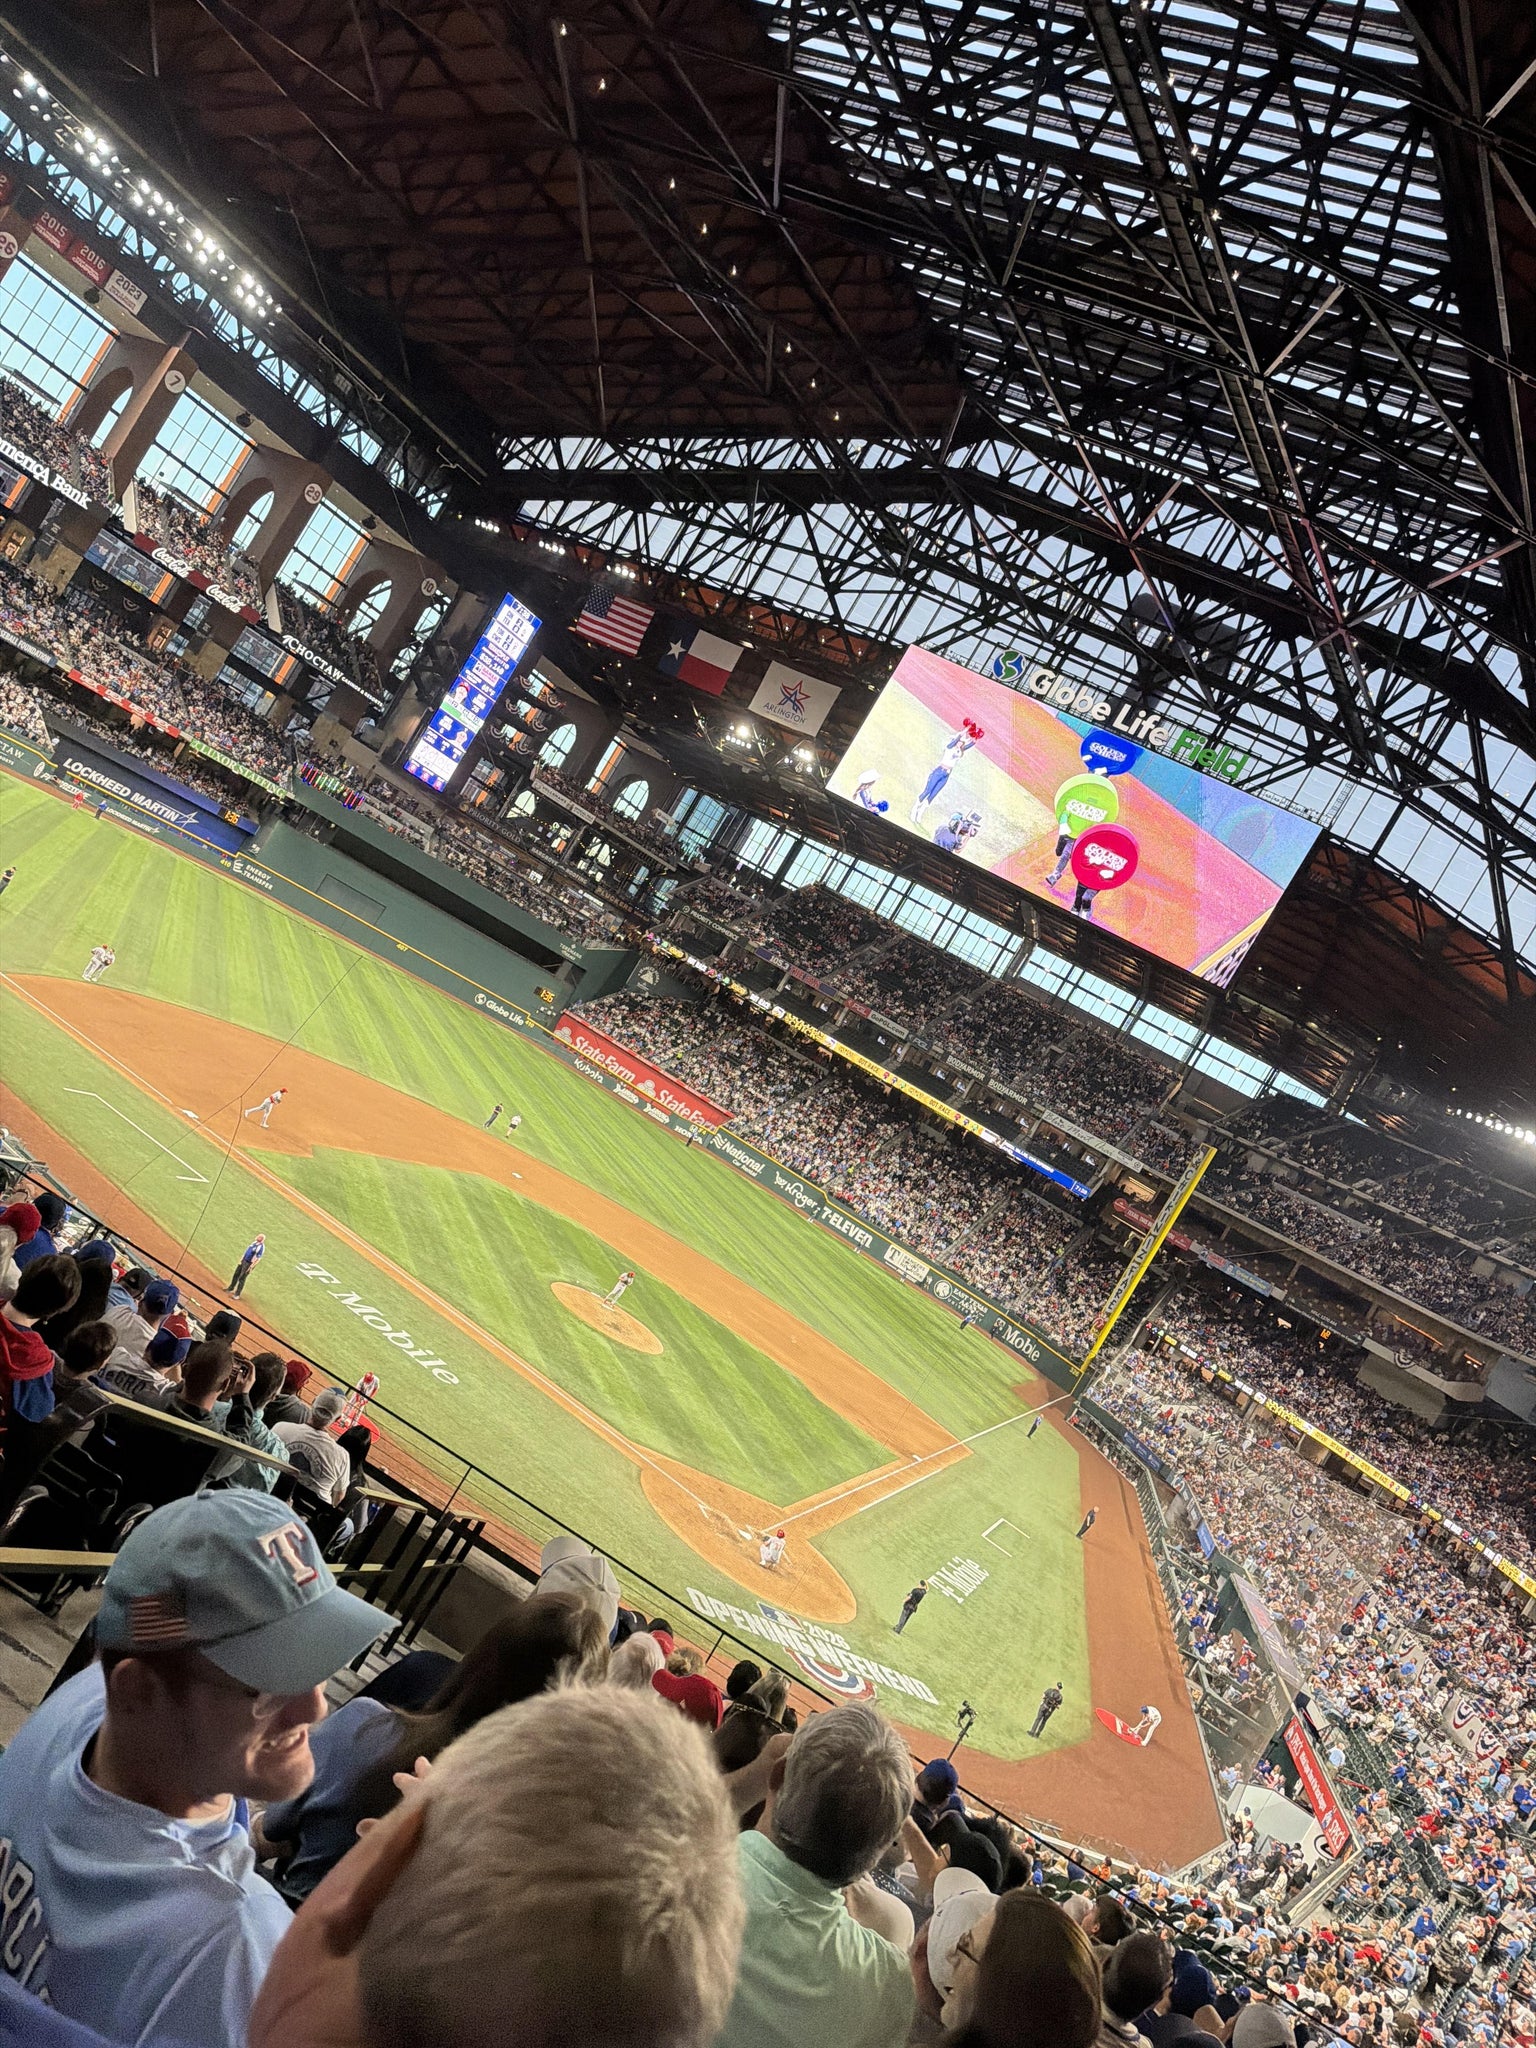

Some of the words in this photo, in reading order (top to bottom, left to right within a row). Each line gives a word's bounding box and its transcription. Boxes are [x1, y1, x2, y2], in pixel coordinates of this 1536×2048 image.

[40, 211, 69, 237] 2015
[79, 245, 107, 270] 2016
[115, 274, 143, 301] 2023
[169, 375, 182, 389] 7
[47, 473, 95, 510] Bank
[306, 485, 321, 502] 29
[423, 579, 436, 592] 10
[16, 638, 52, 664] FOUNDATION
[285, 636, 346, 682] CHOCTAW
[362, 690, 385, 708] RESORTS
[761, 700, 807, 724] ARLINGTON
[1029, 668, 1111, 721] Globe
[1113, 704, 1169, 747] Life
[1172, 729, 1250, 780] Field
[196, 744, 240, 773] LUXOR
[236, 765, 286, 799] STAFFING
[62, 757, 132, 799] LOCKHEED
[131, 791, 180, 824] MARTIN
[466, 805, 504, 833] PRIORITY
[499, 826, 523, 845] GOLD
[241, 870, 274, 890] TRANSFER
[244, 863, 271, 881] ENERGY
[594, 886, 634, 913] PLUCKERS
[688, 908, 713, 926] PRIORITY
[710, 921, 740, 942] COMMERCE
[557, 942, 583, 960] TEREMANA
[768, 953, 790, 971] 105.3
[484, 998, 511, 1018] Globe
[507, 1011, 526, 1026] Life
[867, 1010, 907, 1039] GoPGL.com
[571, 1056, 607, 1084] Kubota
[944, 1053, 986, 1083] BODYARMOR
[986, 1077, 1029, 1107] BODYARMOR
[1042, 1108, 1071, 1131] Blue
[1069, 1124, 1097, 1146] Mint
[719, 1138, 767, 1175] National
[740, 1163, 758, 1178] Rental
[779, 1178, 821, 1214] Kroger
[1151, 1169, 1195, 1235] CHIKIN
[1136, 1237, 1150, 1261] IZ
[952, 1287, 970, 1302] EAST
[967, 1297, 989, 1314] TEXAS
[1105, 1266, 1138, 1313] FARE
[328, 1291, 460, 1386] Mobile
[999, 1324, 1046, 1363] Mobile
[257, 1521, 319, 1587] T
[940, 1555, 990, 1598] Mobile
[686, 1586, 818, 1658] OPENING
[808, 1632, 940, 1706] WEEKEND
[804, 1621, 852, 1652] 2026
